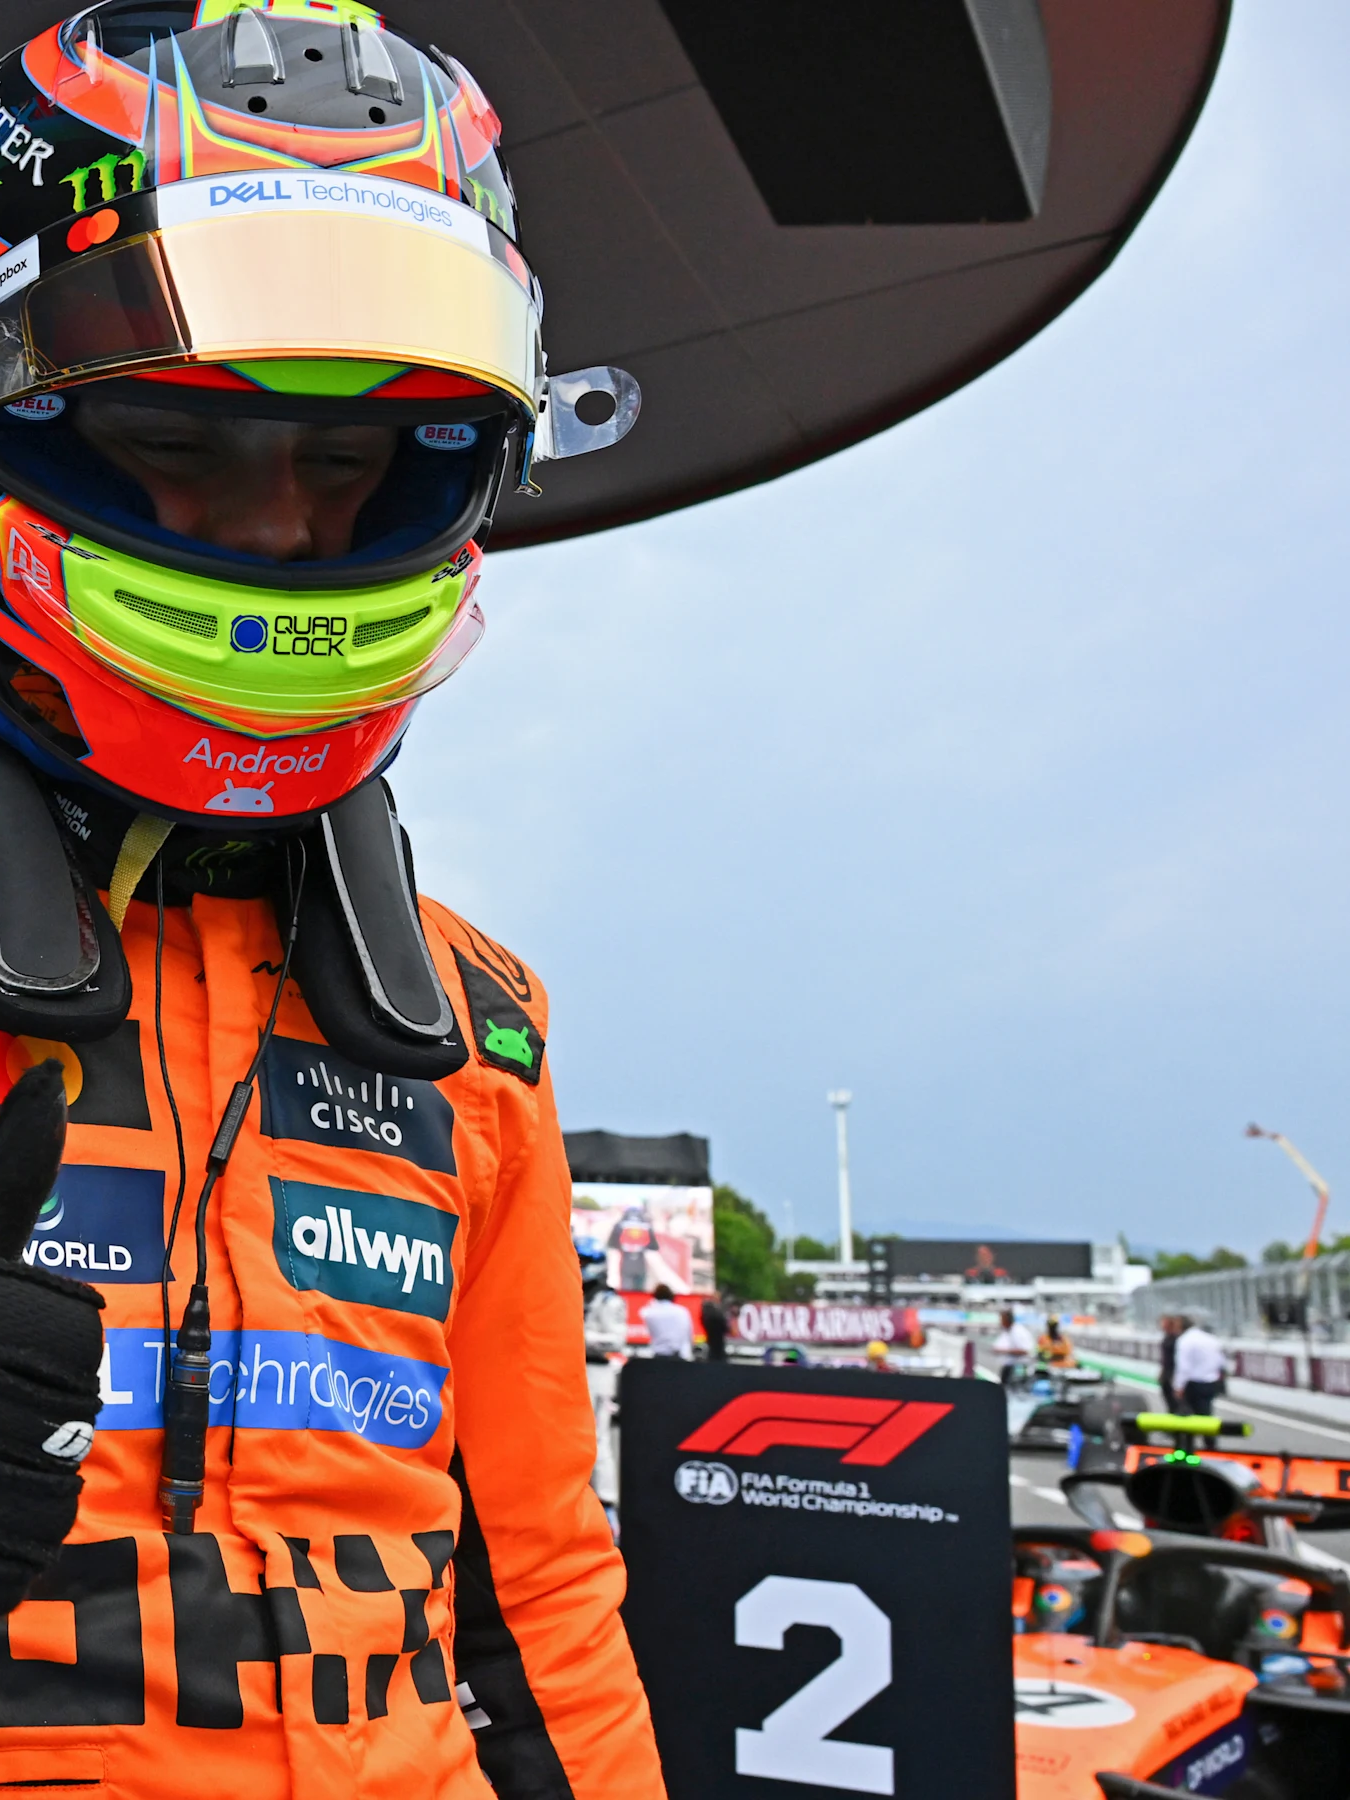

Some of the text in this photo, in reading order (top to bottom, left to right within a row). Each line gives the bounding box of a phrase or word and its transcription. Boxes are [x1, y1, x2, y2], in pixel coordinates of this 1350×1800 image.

[210, 179, 452, 227] DELL Technologies
[424, 426, 467, 441] BELL
[274, 615, 347, 636] QUAD
[272, 637, 346, 657] LOCK
[183, 737, 331, 775] Android
[310, 1101, 403, 1147] CISCO
[292, 1205, 444, 1294] allwyn
[738, 1303, 811, 1342] QATAR
[143, 1341, 431, 1434] Tchnologies
[741, 1472, 871, 1499] FIA Formula 1
[741, 1489, 801, 1509] World
[802, 1494, 944, 1523] Championship
[735, 1575, 895, 1795] 2
